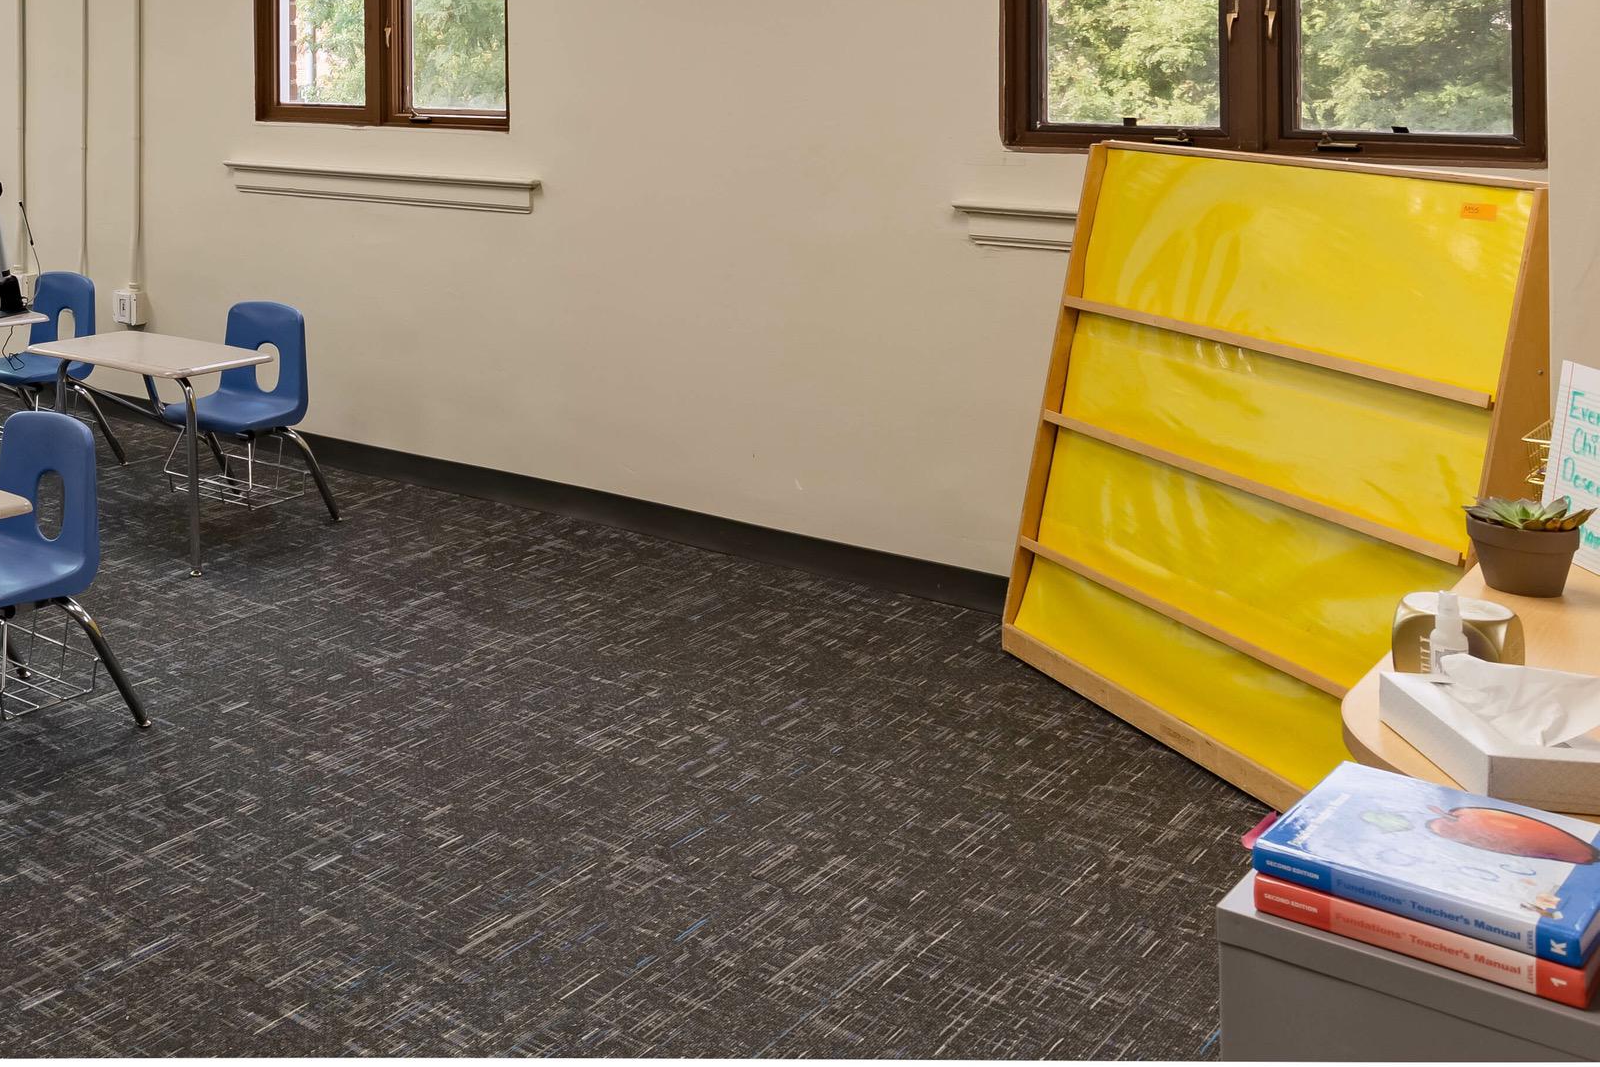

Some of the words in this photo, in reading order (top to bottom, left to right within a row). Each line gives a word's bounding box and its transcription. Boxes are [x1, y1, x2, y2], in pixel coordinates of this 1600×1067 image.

[1264, 893, 1290, 904] SECOND
[1291, 900, 1318, 914] EDITION
[1409, 934, 1470, 960] Teacher's
[1474, 953, 1521, 975] Manual
[1266, 860, 1291, 872] SECOND
[1292, 867, 1320, 880] EDITION
[1410, 900, 1470, 926] Teacher's
[1474, 918, 1521, 940] Manual
[1550, 938, 1568, 956] K
